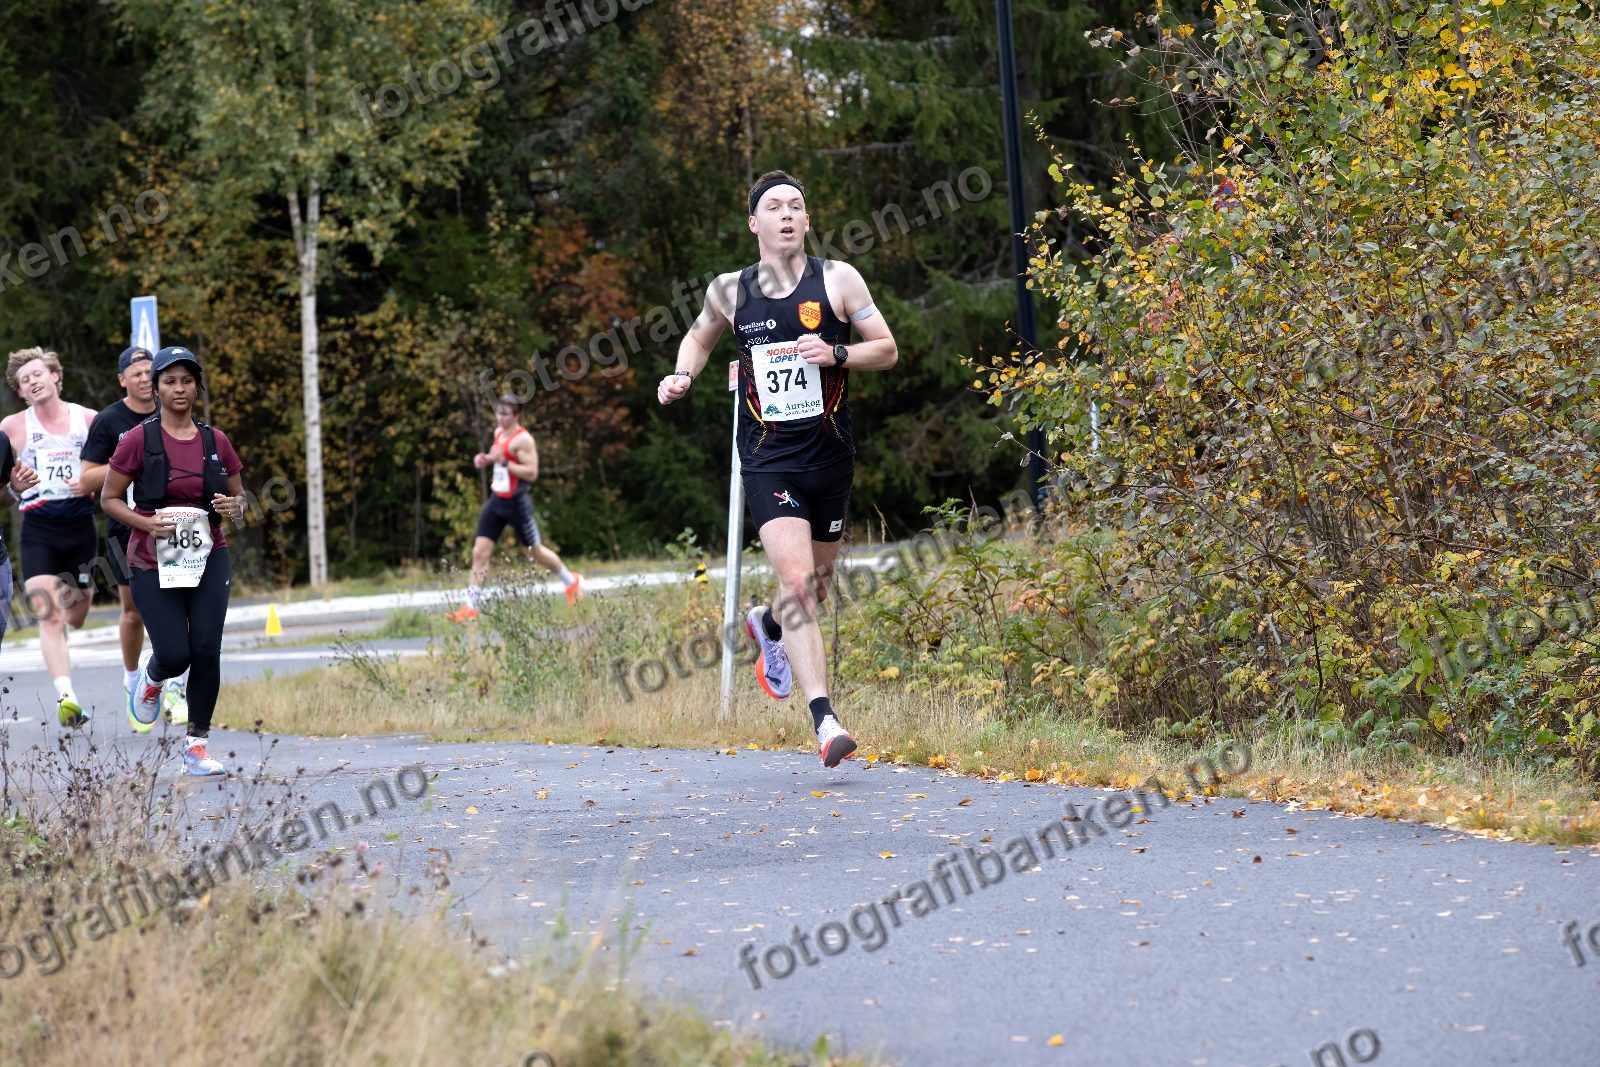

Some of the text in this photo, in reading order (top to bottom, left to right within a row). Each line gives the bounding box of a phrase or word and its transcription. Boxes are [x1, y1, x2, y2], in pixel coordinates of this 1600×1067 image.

[766, 346, 799, 357] NORGE
[769, 353, 800, 364] LØPET
[766, 367, 808, 394] 374
[784, 399, 821, 411] Aurskog
[46, 464, 73, 481] 743
[167, 528, 203, 550] 485
